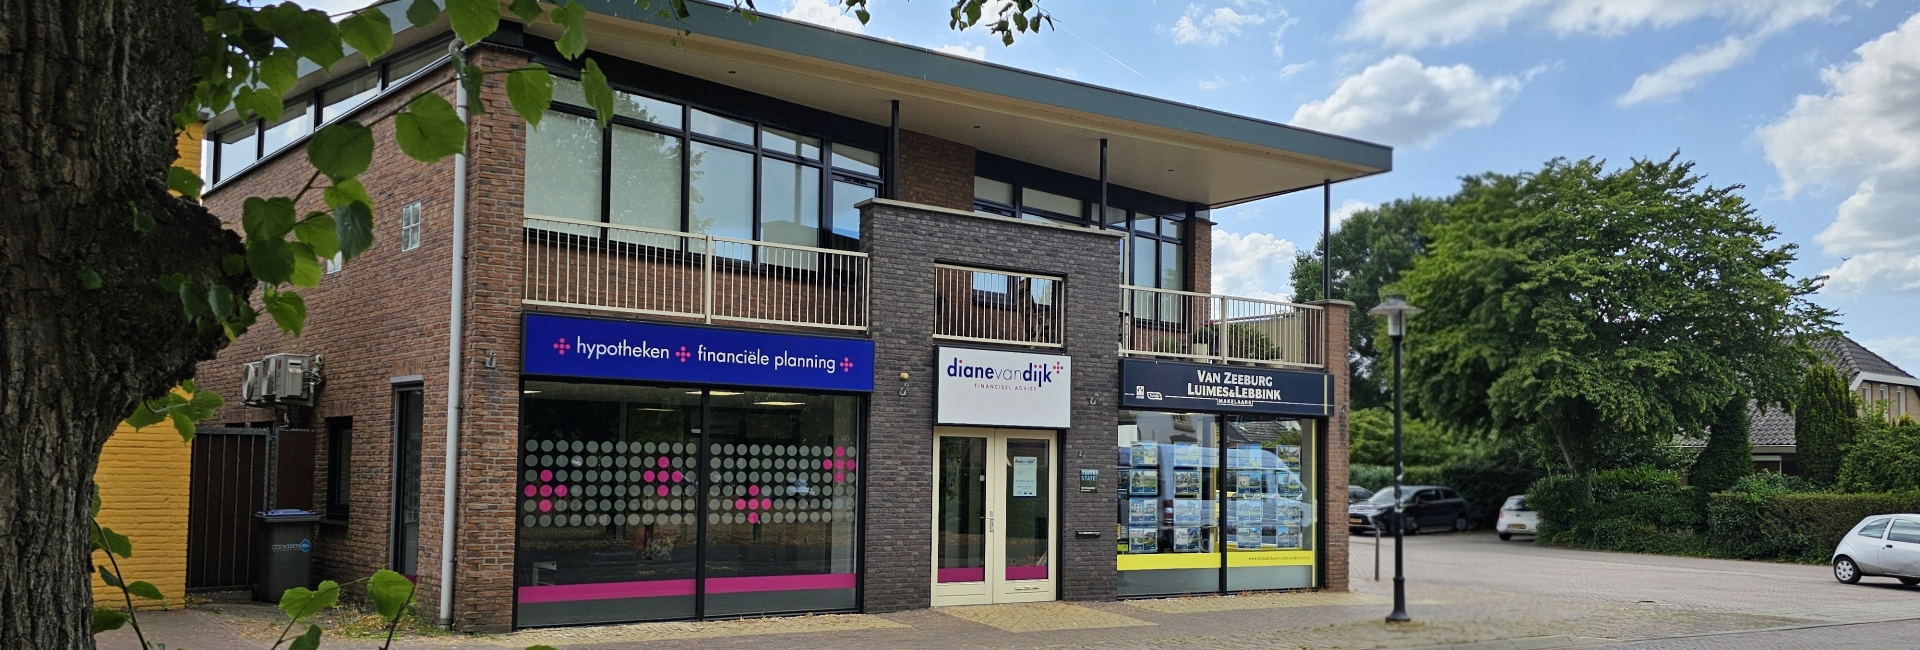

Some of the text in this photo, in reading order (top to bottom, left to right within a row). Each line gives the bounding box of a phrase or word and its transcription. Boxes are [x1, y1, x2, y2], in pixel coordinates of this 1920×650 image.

[576, 336, 836, 373] hypotheken financiële planning
[1196, 369, 1273, 387] VAN ZEEBURG
